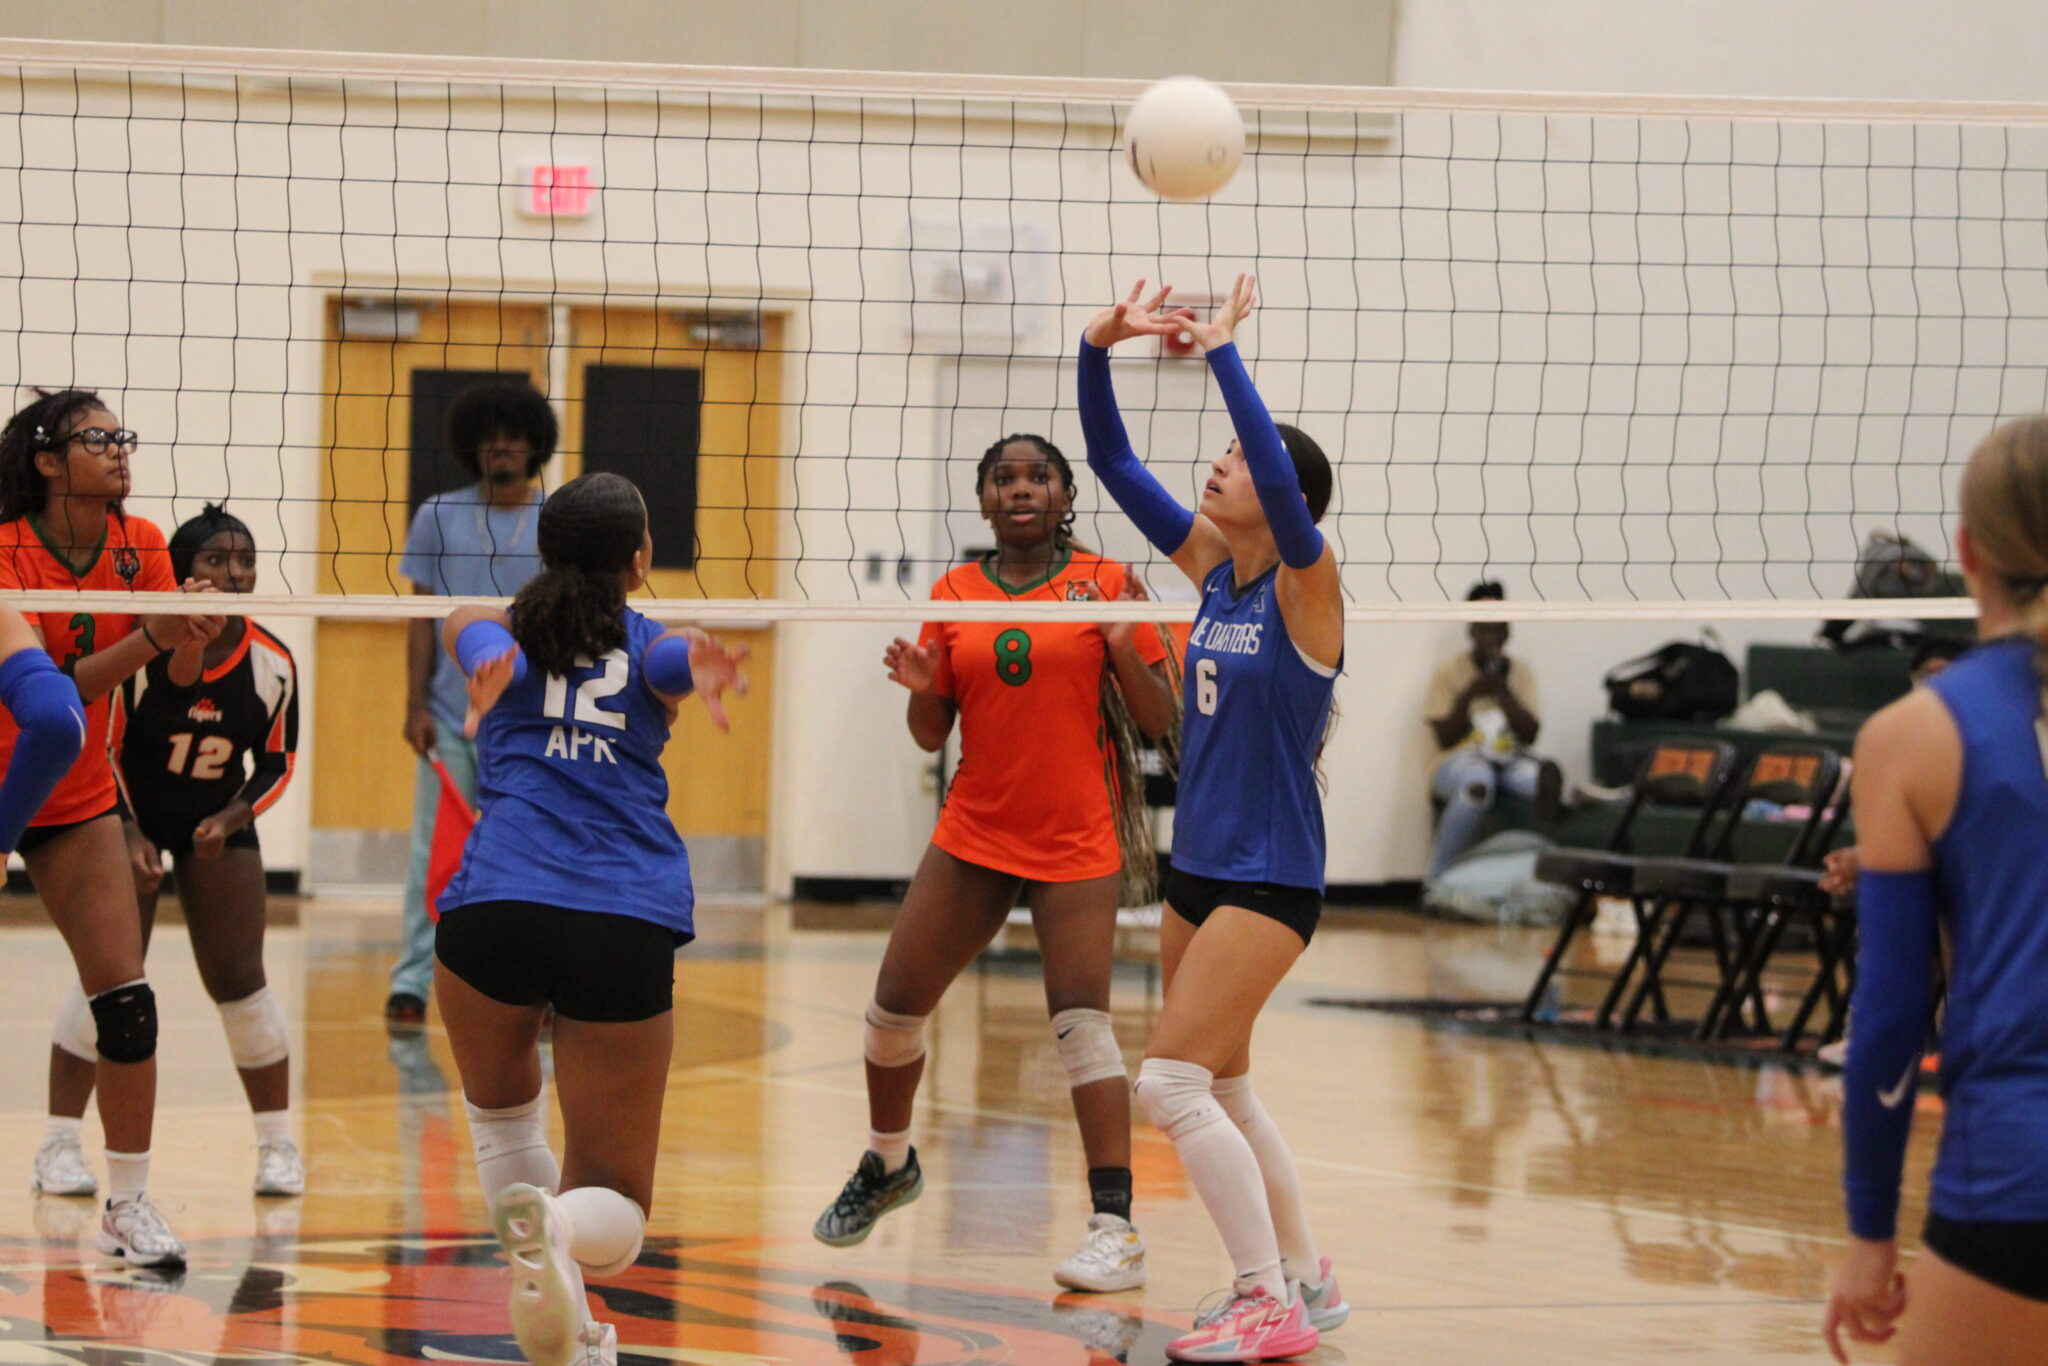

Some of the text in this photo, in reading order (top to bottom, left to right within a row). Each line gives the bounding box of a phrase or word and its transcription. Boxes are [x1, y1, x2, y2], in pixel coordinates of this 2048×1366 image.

[65, 613, 95, 665] 3
[995, 629, 1032, 686] 8
[544, 649, 629, 730] 12
[1196, 658, 1217, 717] 6
[167, 733, 233, 779] 12
